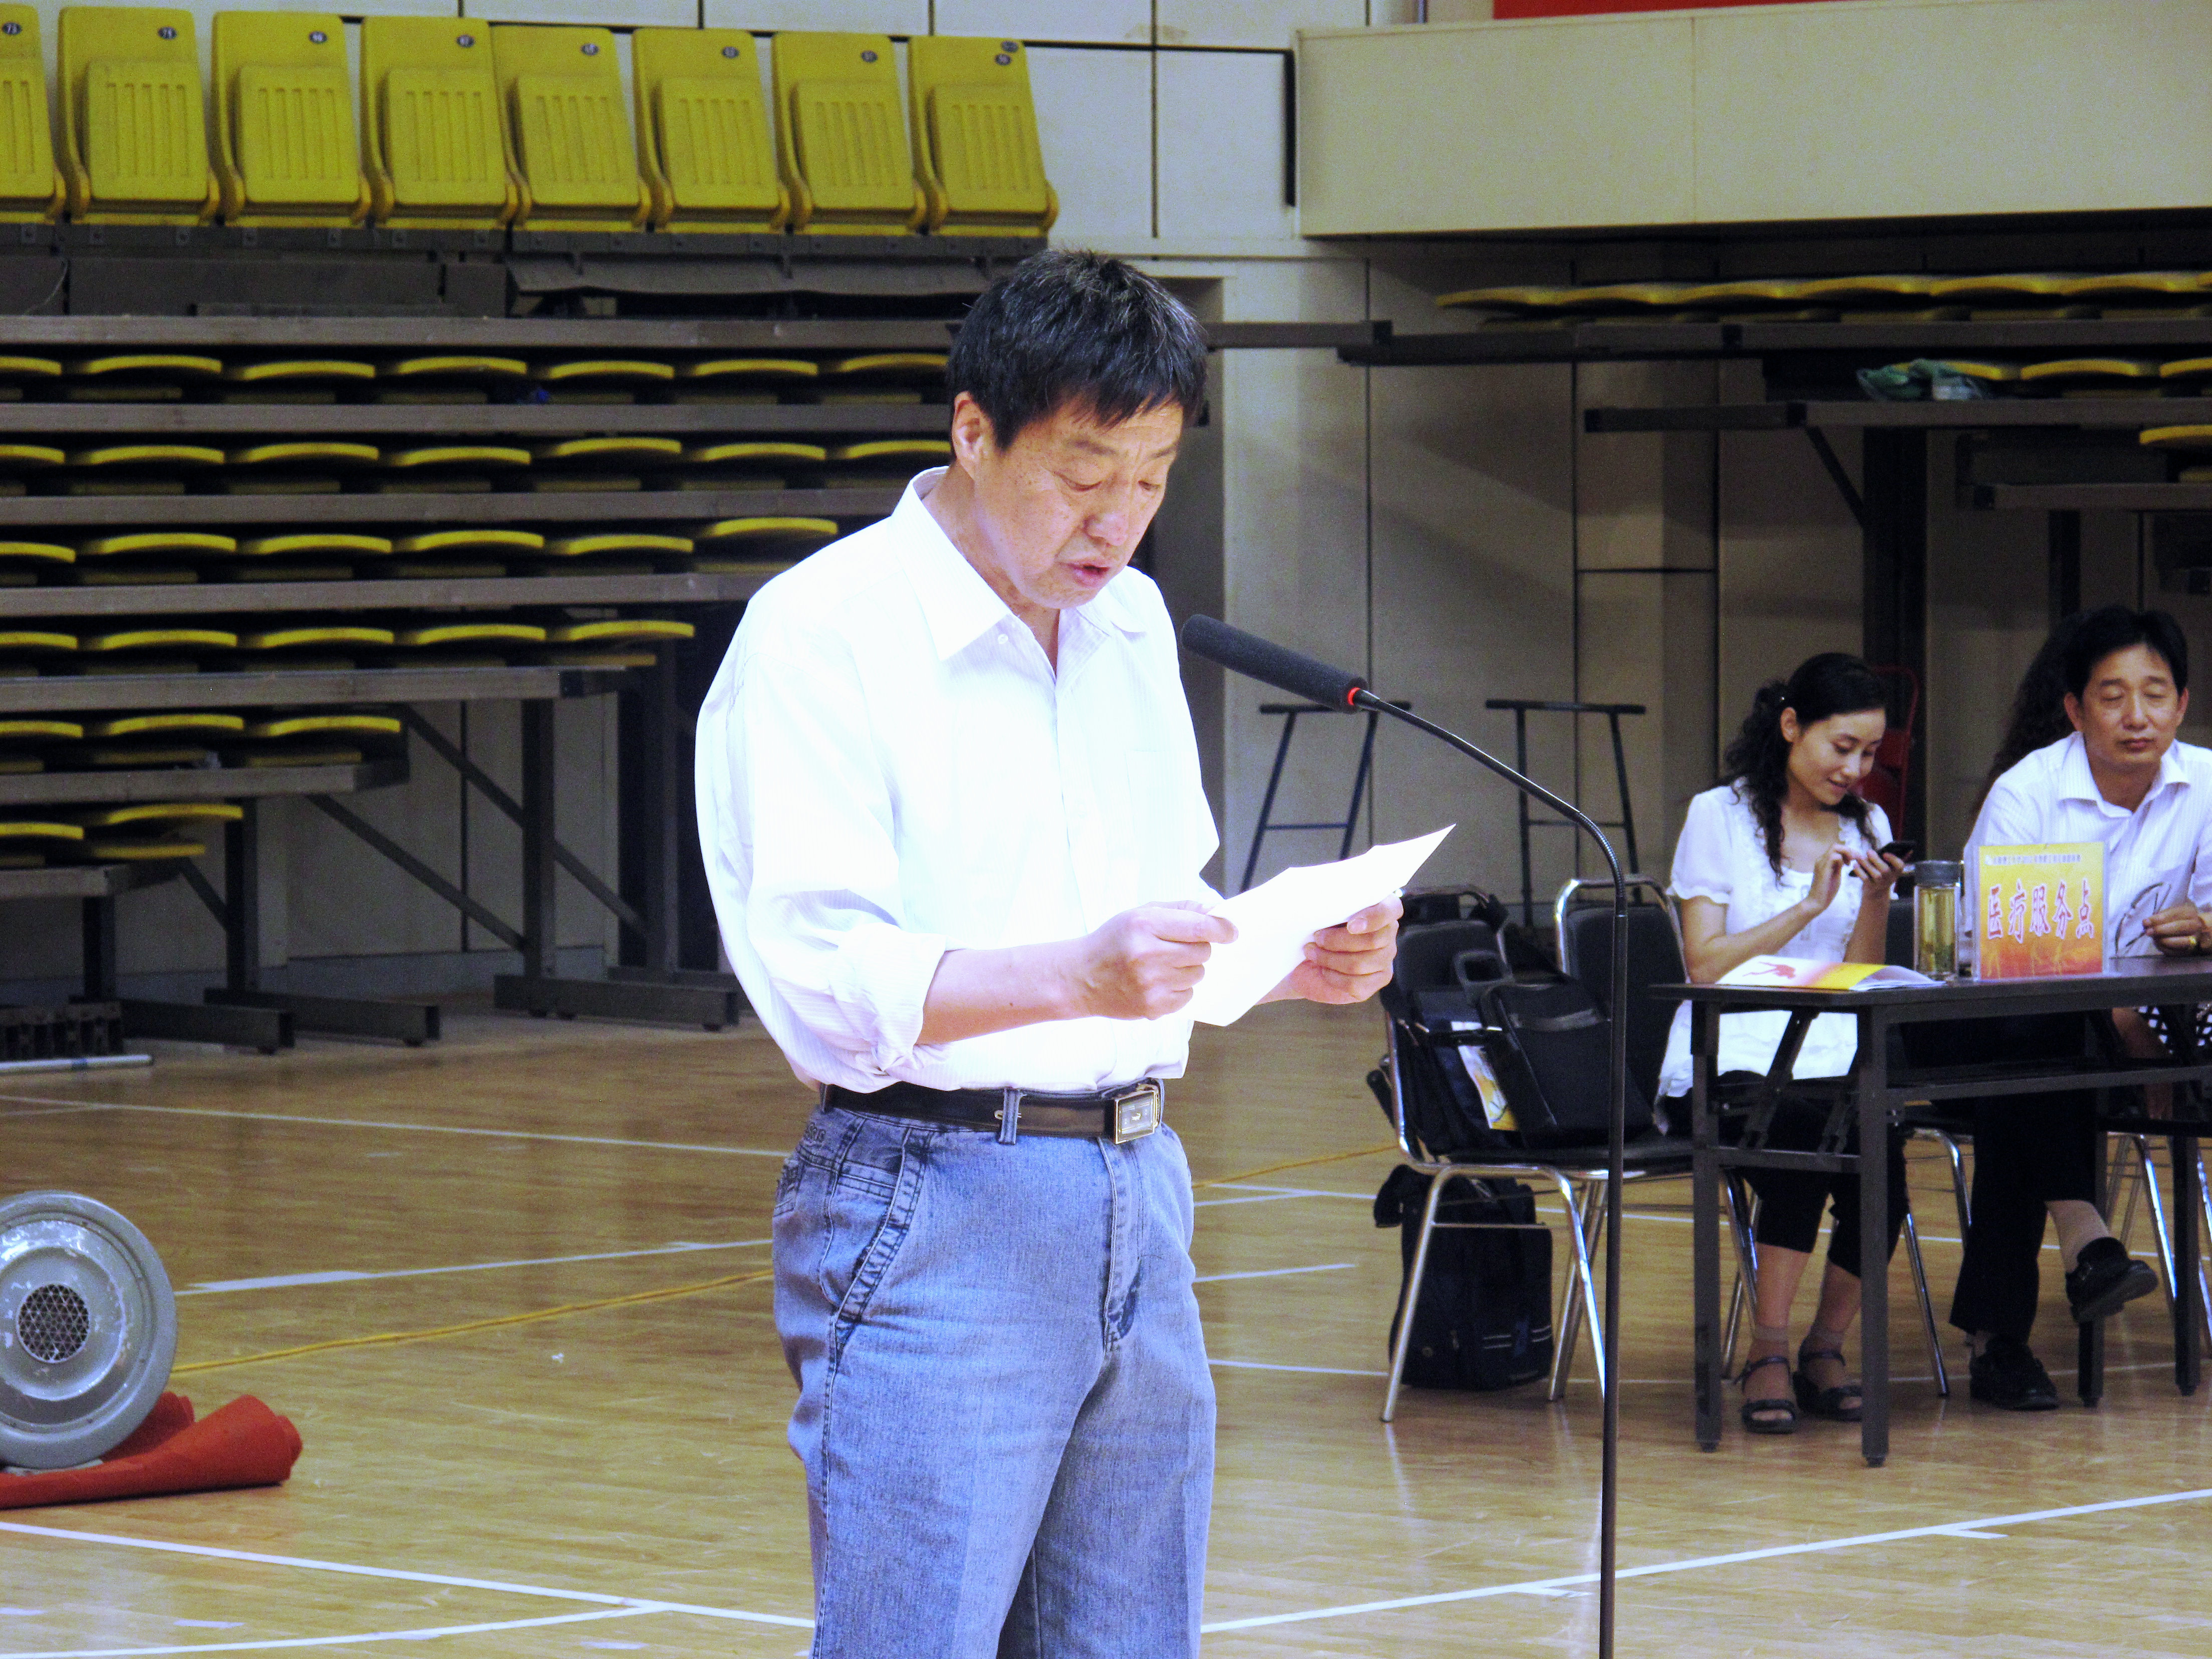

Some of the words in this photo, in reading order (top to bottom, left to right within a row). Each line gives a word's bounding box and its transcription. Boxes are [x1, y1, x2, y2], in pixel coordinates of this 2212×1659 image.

[1987, 878, 2094, 944] 医疗服务点
